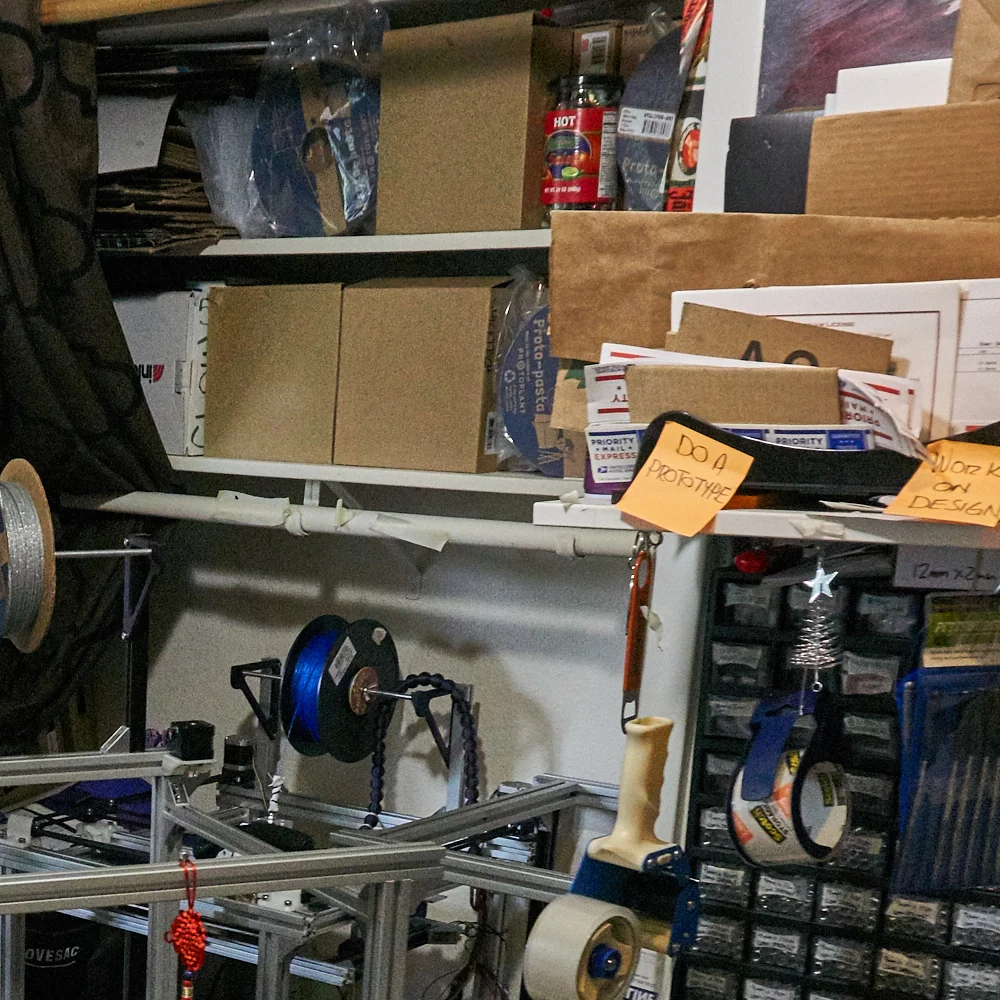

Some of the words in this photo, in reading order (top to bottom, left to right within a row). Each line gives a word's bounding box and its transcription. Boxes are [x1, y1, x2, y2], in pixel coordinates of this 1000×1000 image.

[553, 115, 577, 128] HOT
[532, 318, 546, 413] Proto-pasta
[591, 437, 634, 446] PRIORITY
[776, 437, 823, 446] PRIORITY
[595, 452, 637, 460] EXPRESS
[676, 433, 708, 463] DO
[713, 453, 727, 473] A
[646, 458, 732, 504] PROTOTYPE
[932, 481, 971, 494] ON
[908, 495, 1000, 519] DESIGN
[25, 945, 80, 962] OVESAC
